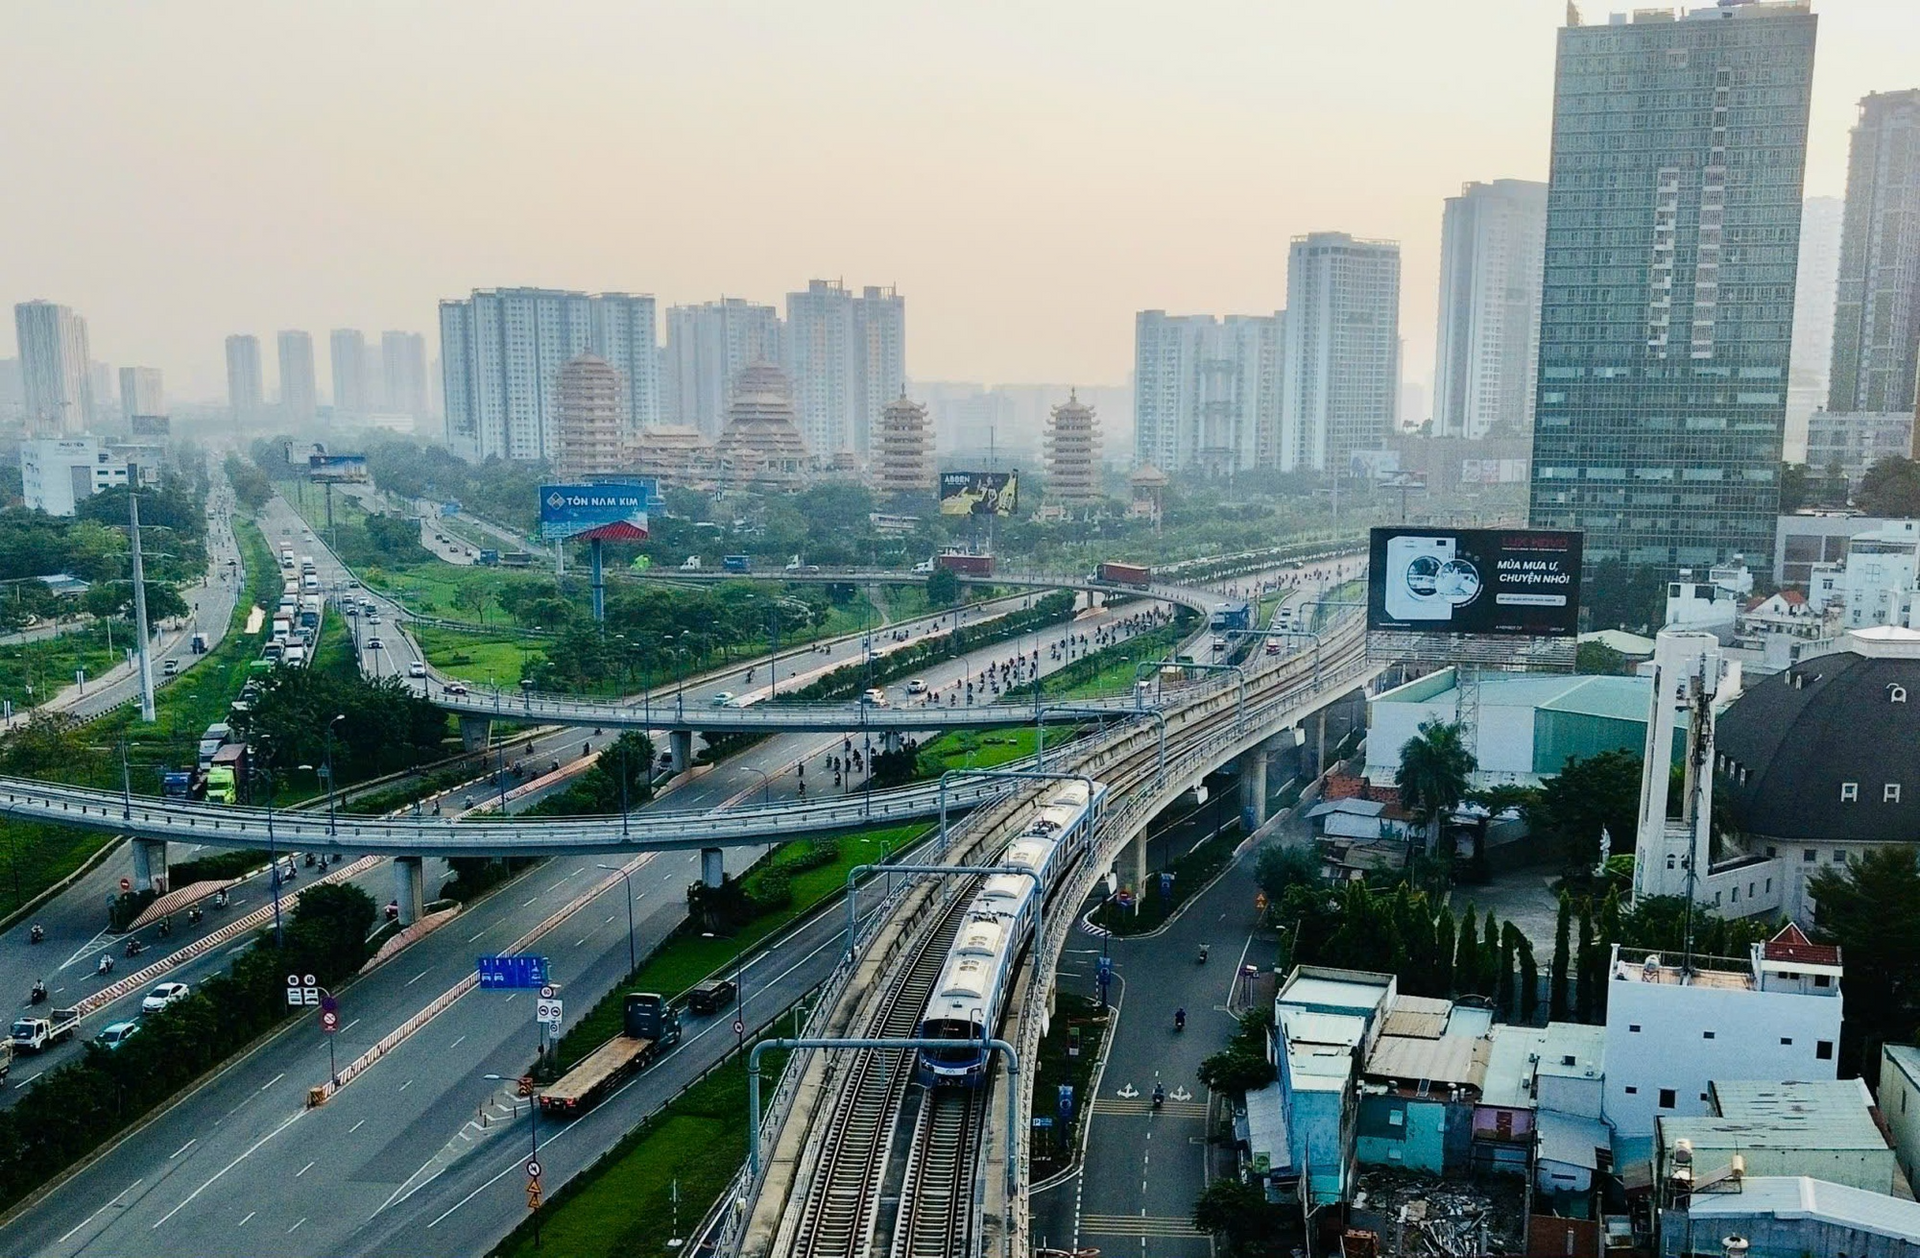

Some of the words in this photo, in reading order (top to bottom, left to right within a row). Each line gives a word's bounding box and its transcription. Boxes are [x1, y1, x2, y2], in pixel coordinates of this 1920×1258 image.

[566, 495, 588, 506] TÔN
[591, 497, 616, 506] NAM
[619, 497, 639, 506] KIM
[1522, 560, 1547, 570] MƯA
[1499, 571, 1542, 585] CHUYỆN
[1542, 572, 1570, 584] NHỎ!
